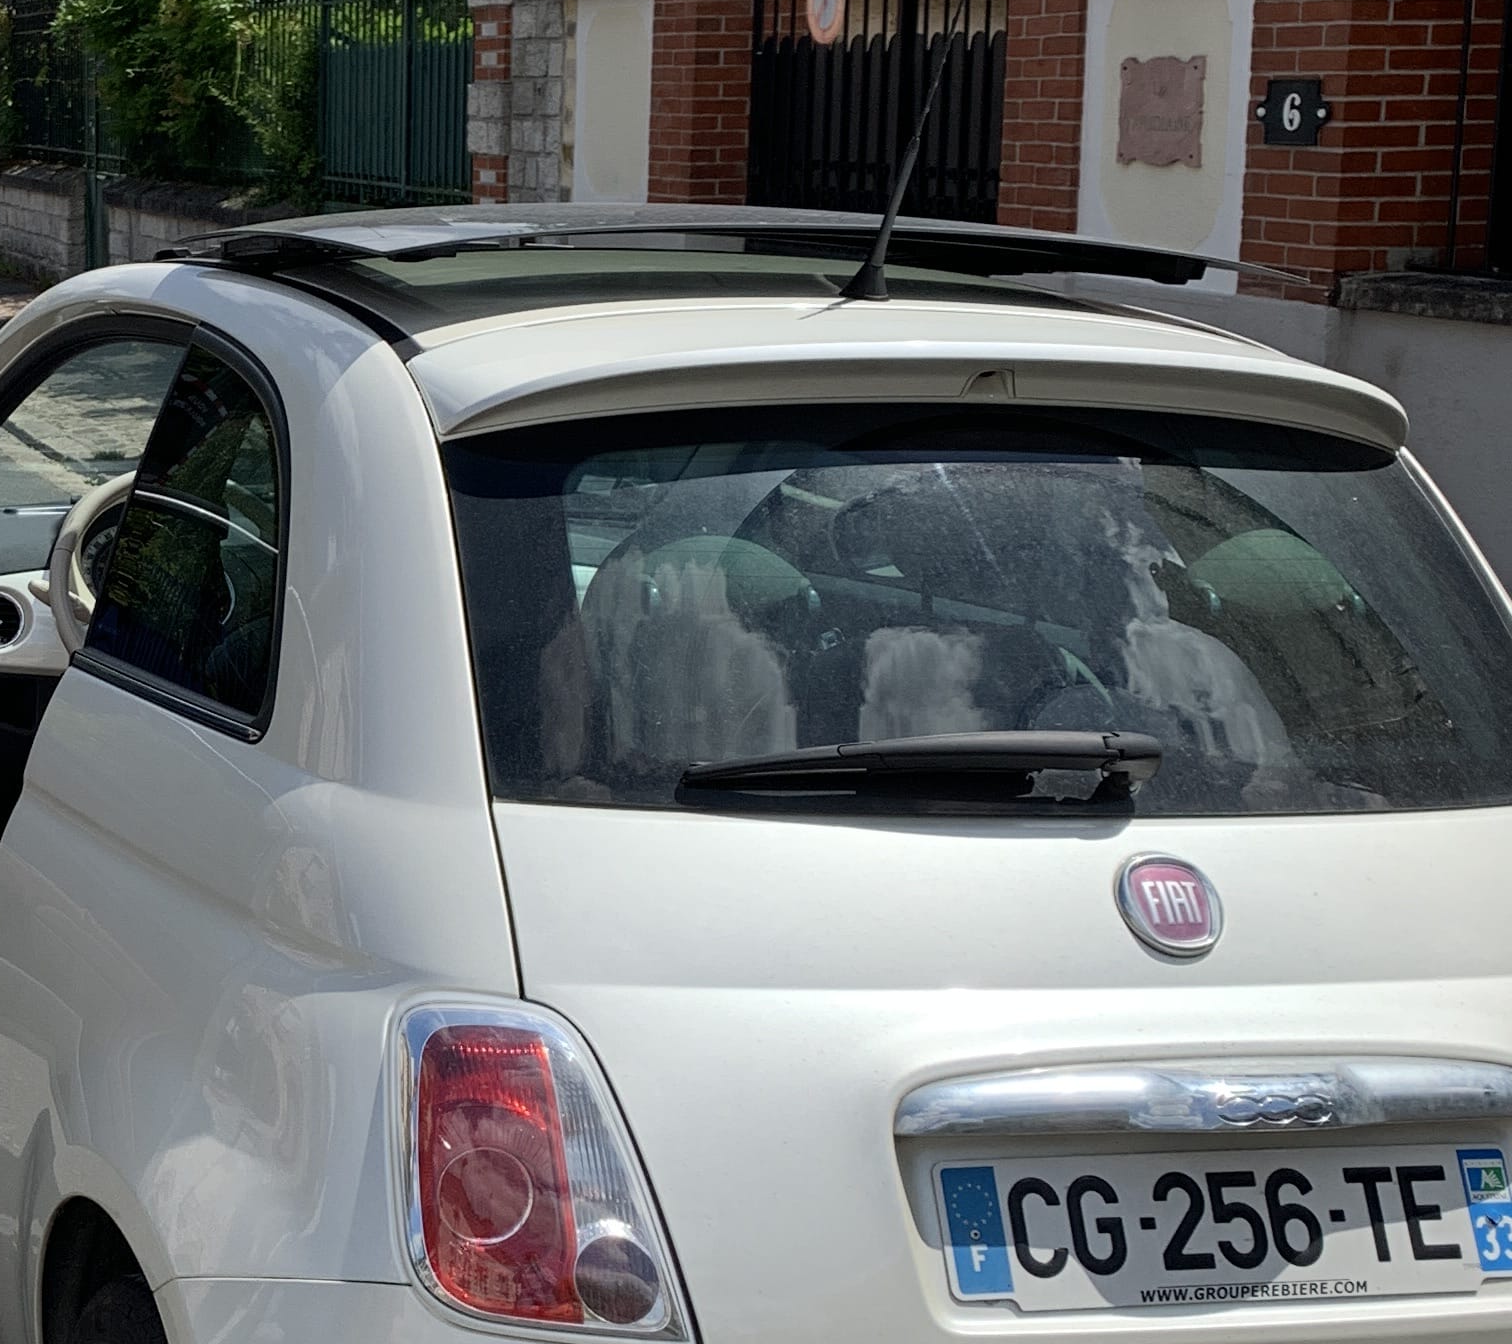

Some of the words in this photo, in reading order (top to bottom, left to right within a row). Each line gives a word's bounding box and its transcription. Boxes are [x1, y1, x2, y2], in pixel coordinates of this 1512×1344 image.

[1282, 92, 1302, 132] 6
[1140, 880, 1203, 925] FIAT
[970, 1244, 988, 1273] F
[1140, 1280, 1368, 1303] WWW.GROUPEREBIERE.COM
